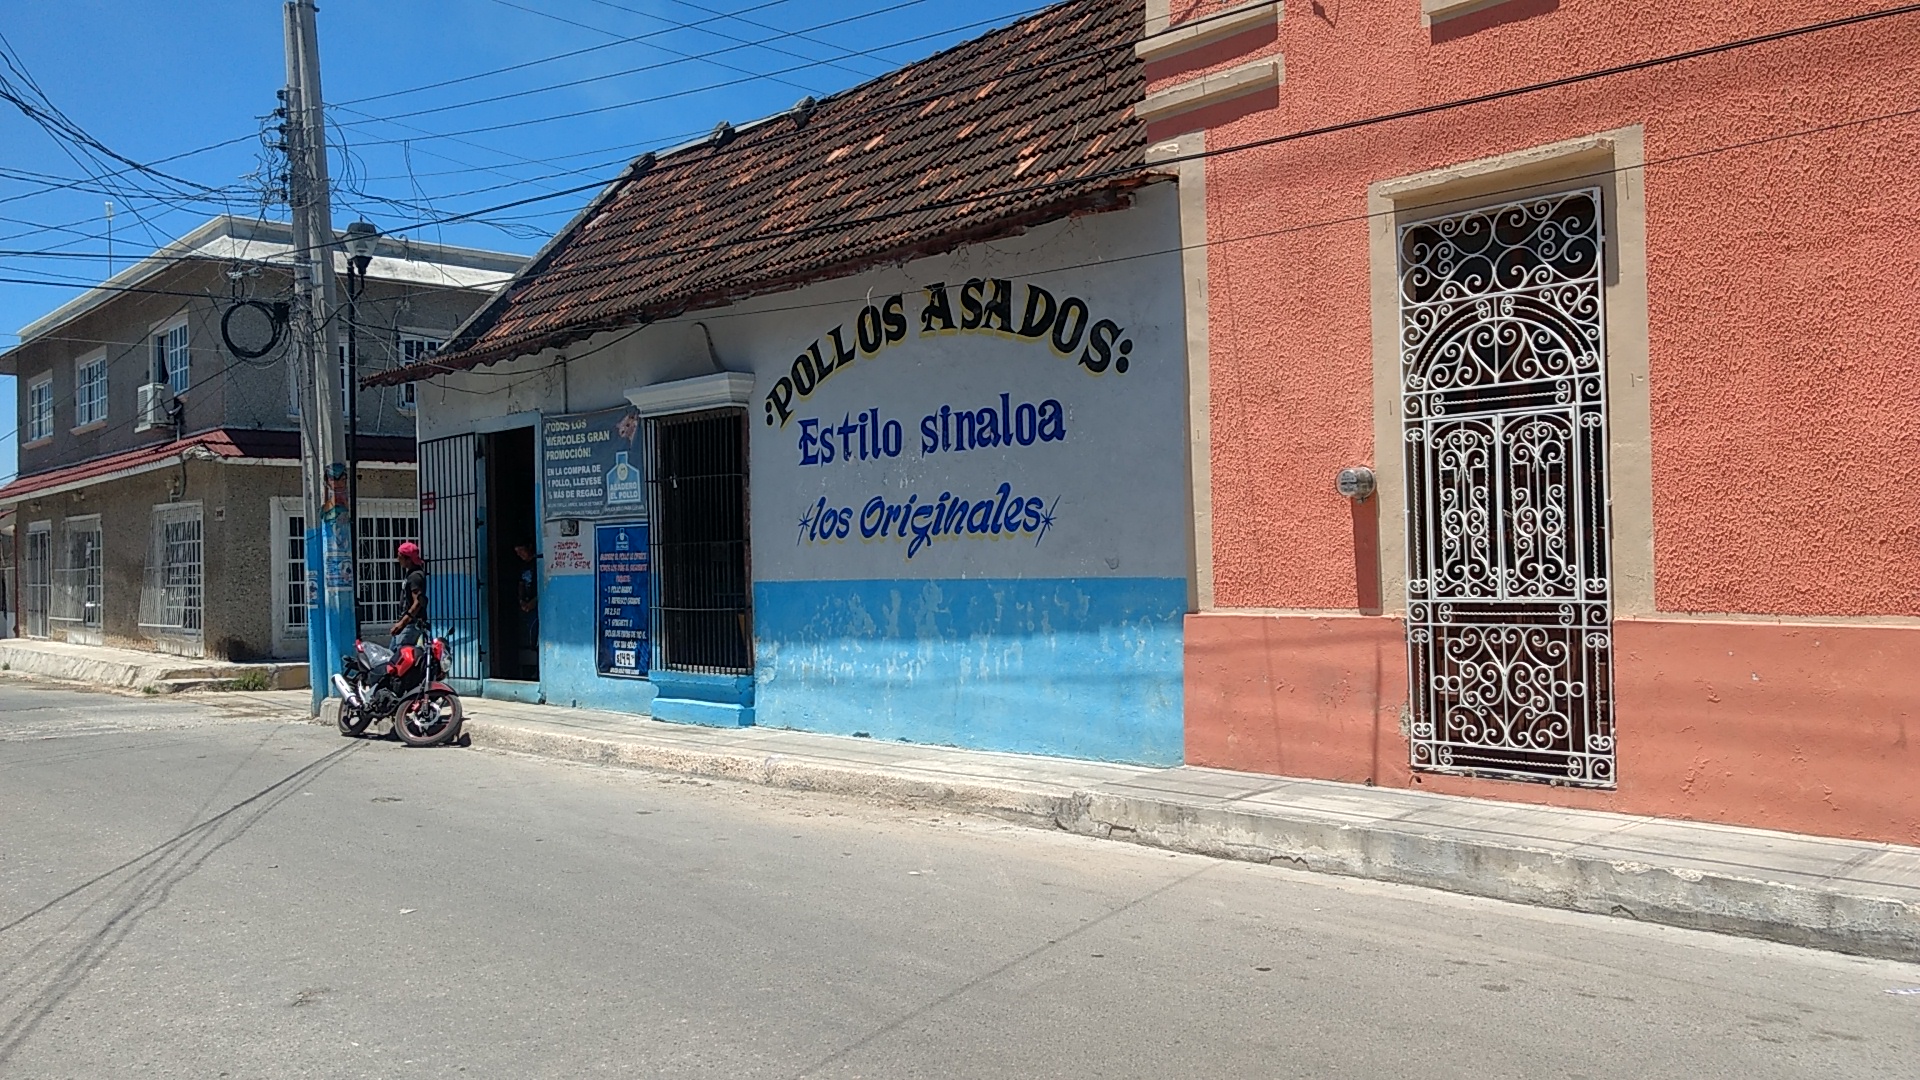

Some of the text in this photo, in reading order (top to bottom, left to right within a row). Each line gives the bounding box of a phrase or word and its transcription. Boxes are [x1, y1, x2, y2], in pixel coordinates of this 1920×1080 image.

[571, 419, 587, 429] LOS
[798, 392, 1067, 466] Estilo sinaloa
[587, 430, 610, 443] GRAN
[546, 446, 592, 460] PROMOCIÓN!
[547, 464, 602, 476] EN LA COMPRA DE
[572, 476, 602, 486] LLEVESE
[610, 482, 637, 491] ASADERO
[566, 489, 575, 498] DE
[576, 488, 603, 498] REGALO
[610, 491, 639, 500] EL POLLO
[809, 482, 1043, 559] los Originales
